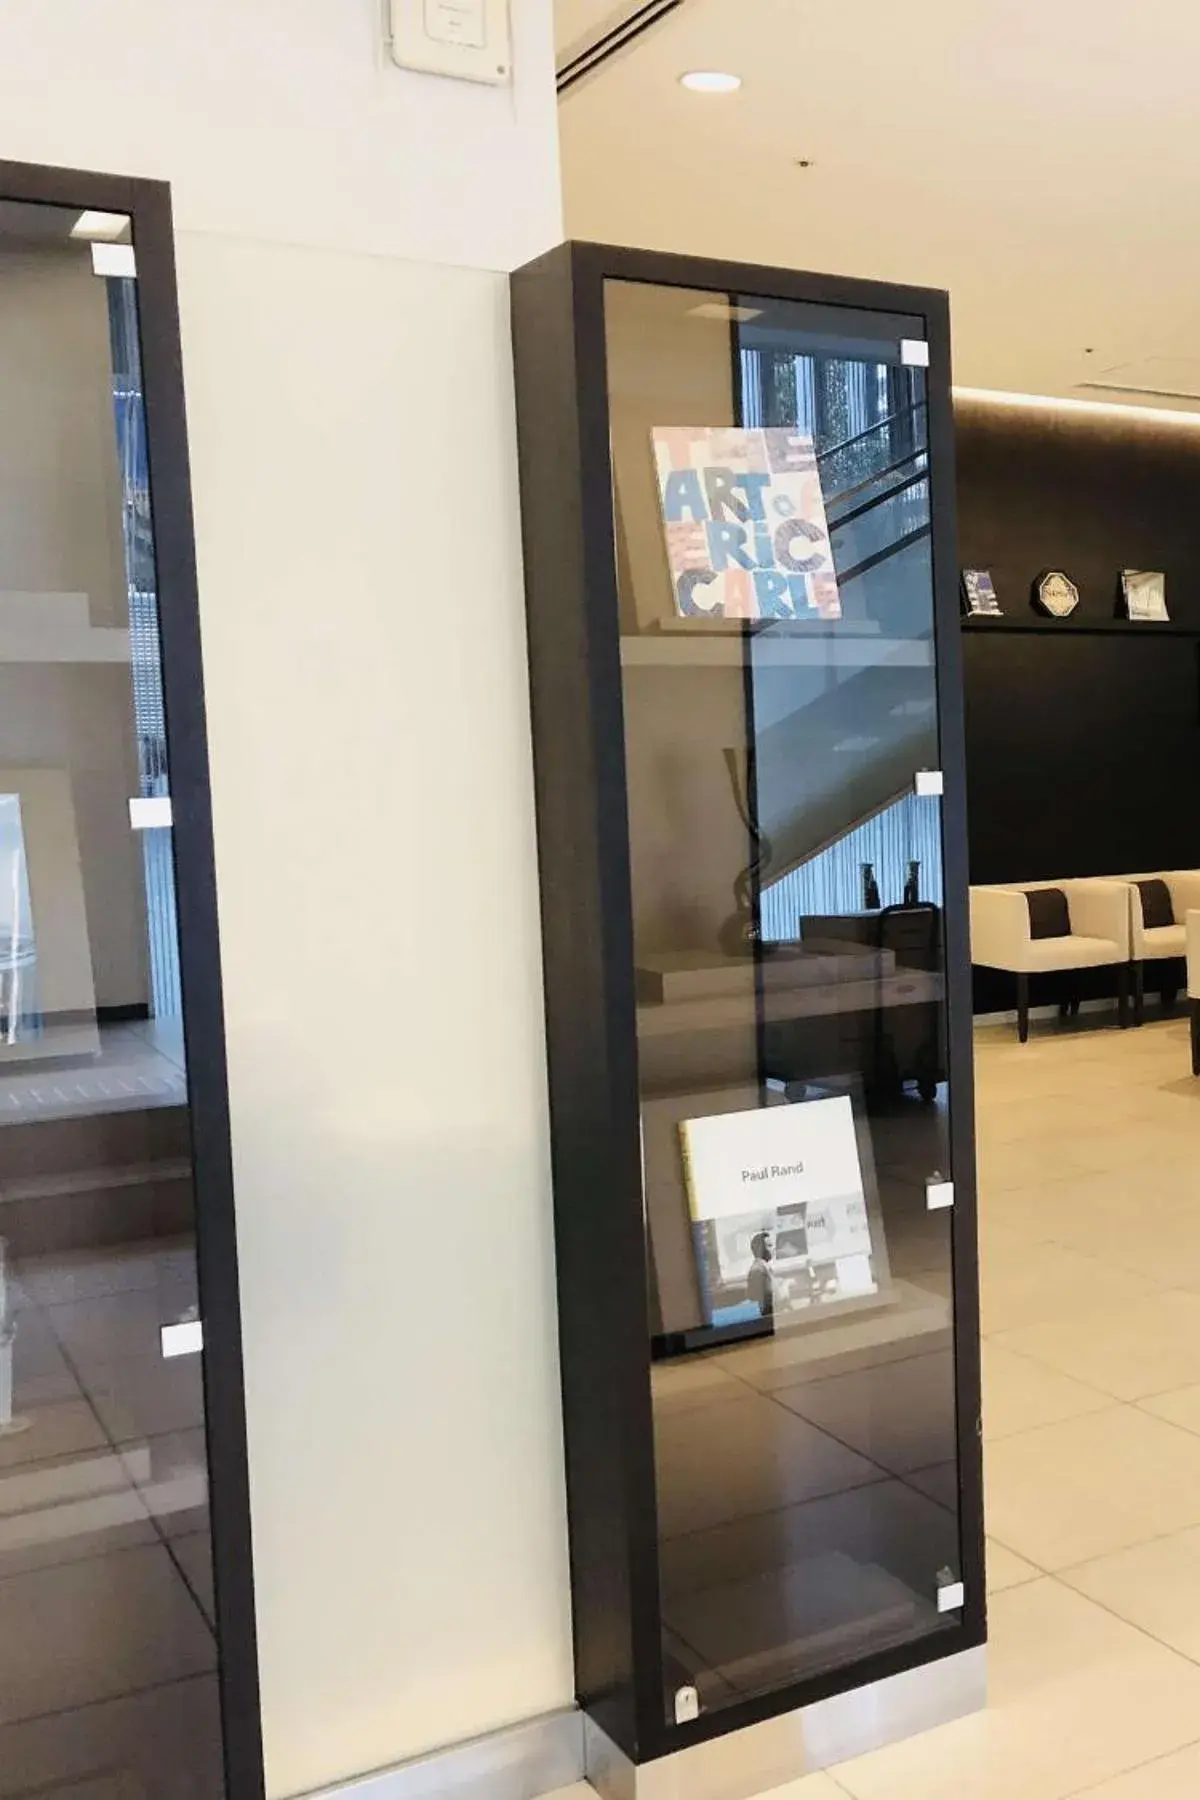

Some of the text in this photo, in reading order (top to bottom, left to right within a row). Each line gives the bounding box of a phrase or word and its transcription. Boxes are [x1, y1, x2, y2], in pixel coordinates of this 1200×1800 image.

[664, 467, 771, 523] ART
[677, 567, 840, 619] CARLE
[741, 1161, 804, 1182] Paul Rand
